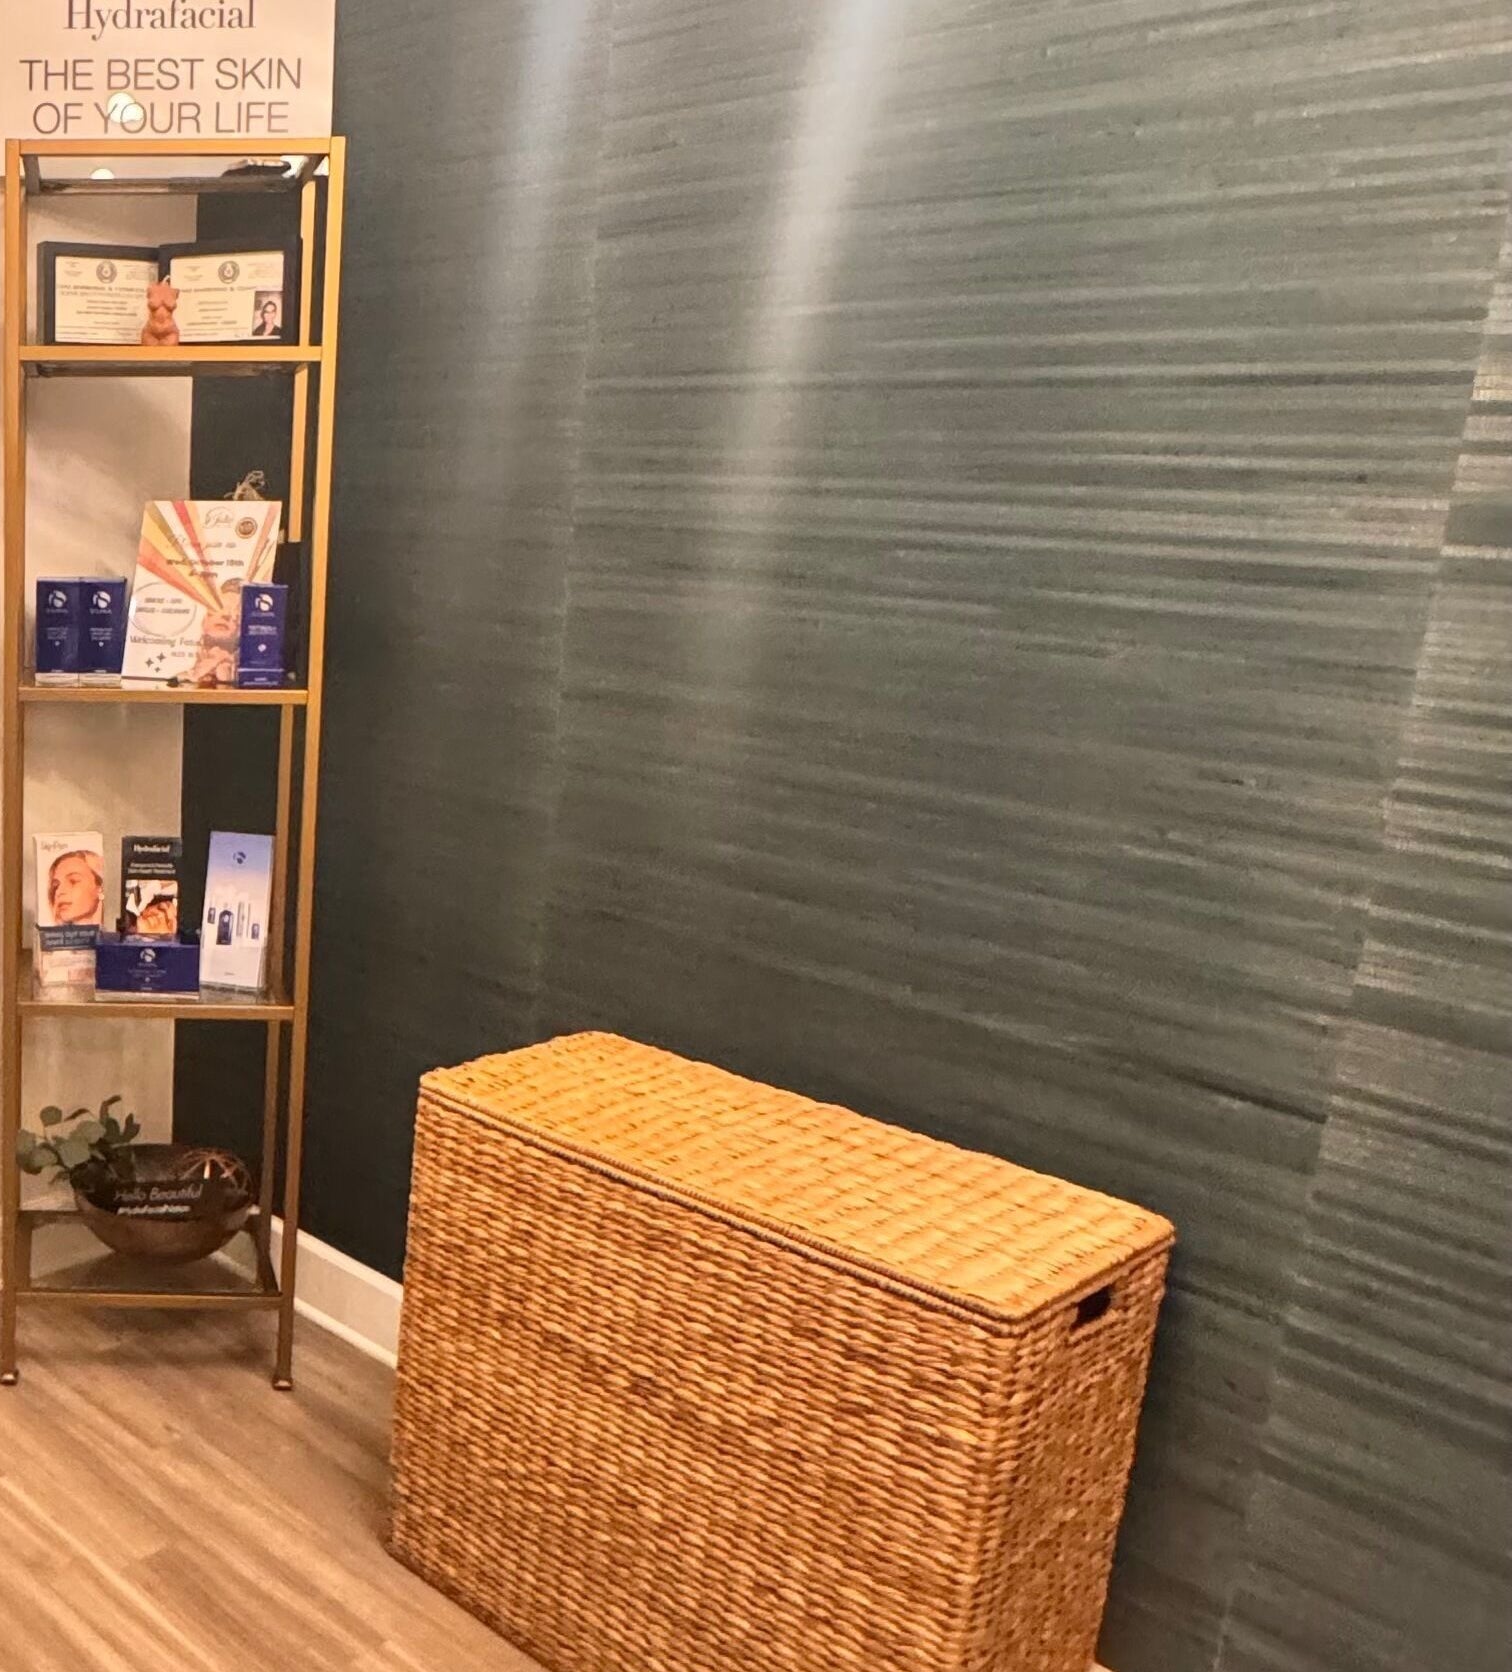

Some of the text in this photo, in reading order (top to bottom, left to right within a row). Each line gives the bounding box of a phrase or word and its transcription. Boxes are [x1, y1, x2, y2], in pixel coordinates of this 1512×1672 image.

[63, 0, 256, 41] Hydrafacial
[19, 57, 301, 91] THE BEST SKIN
[32, 101, 289, 134] OF YOUR LIFE
